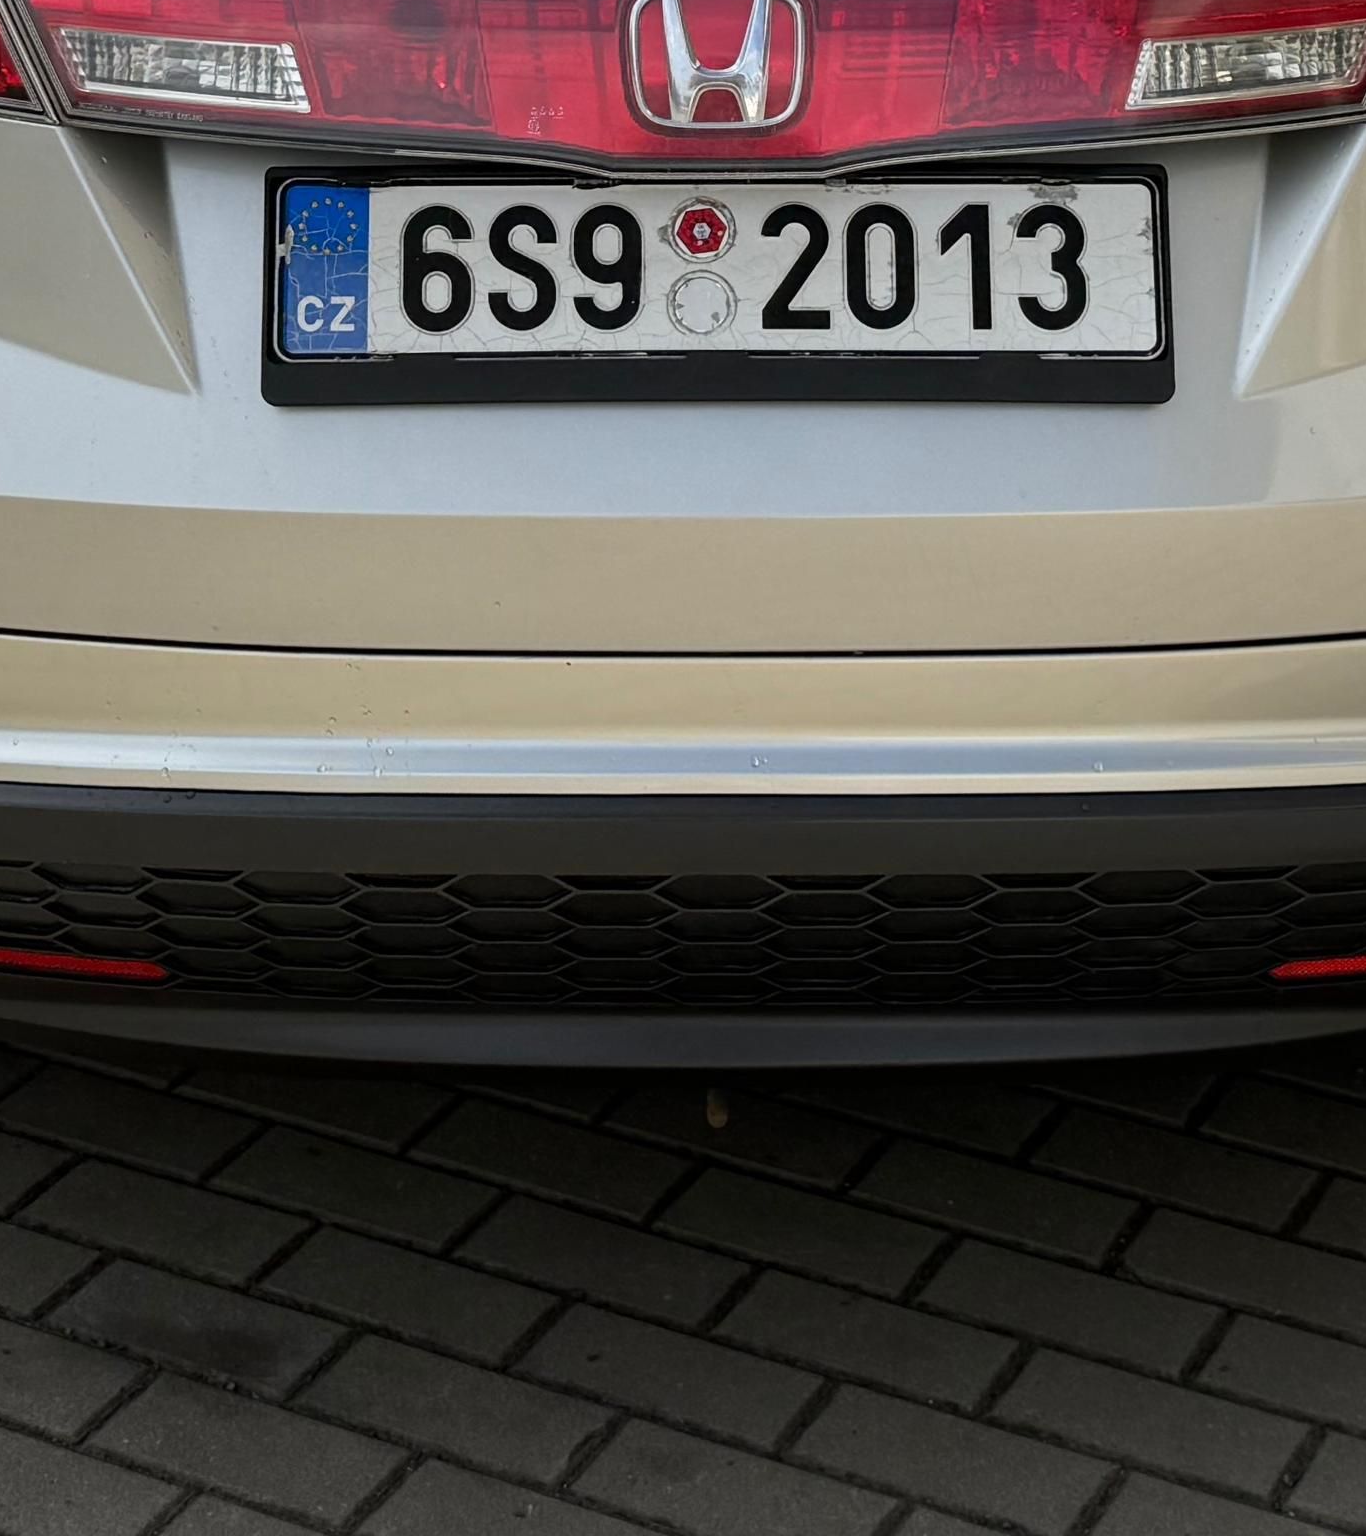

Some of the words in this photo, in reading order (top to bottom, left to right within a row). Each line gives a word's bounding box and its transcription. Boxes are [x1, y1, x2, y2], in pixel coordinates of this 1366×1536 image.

[401, 202, 645, 332] 6S9
[761, 202, 1088, 332] 2013
[296, 297, 355, 333] CZ
